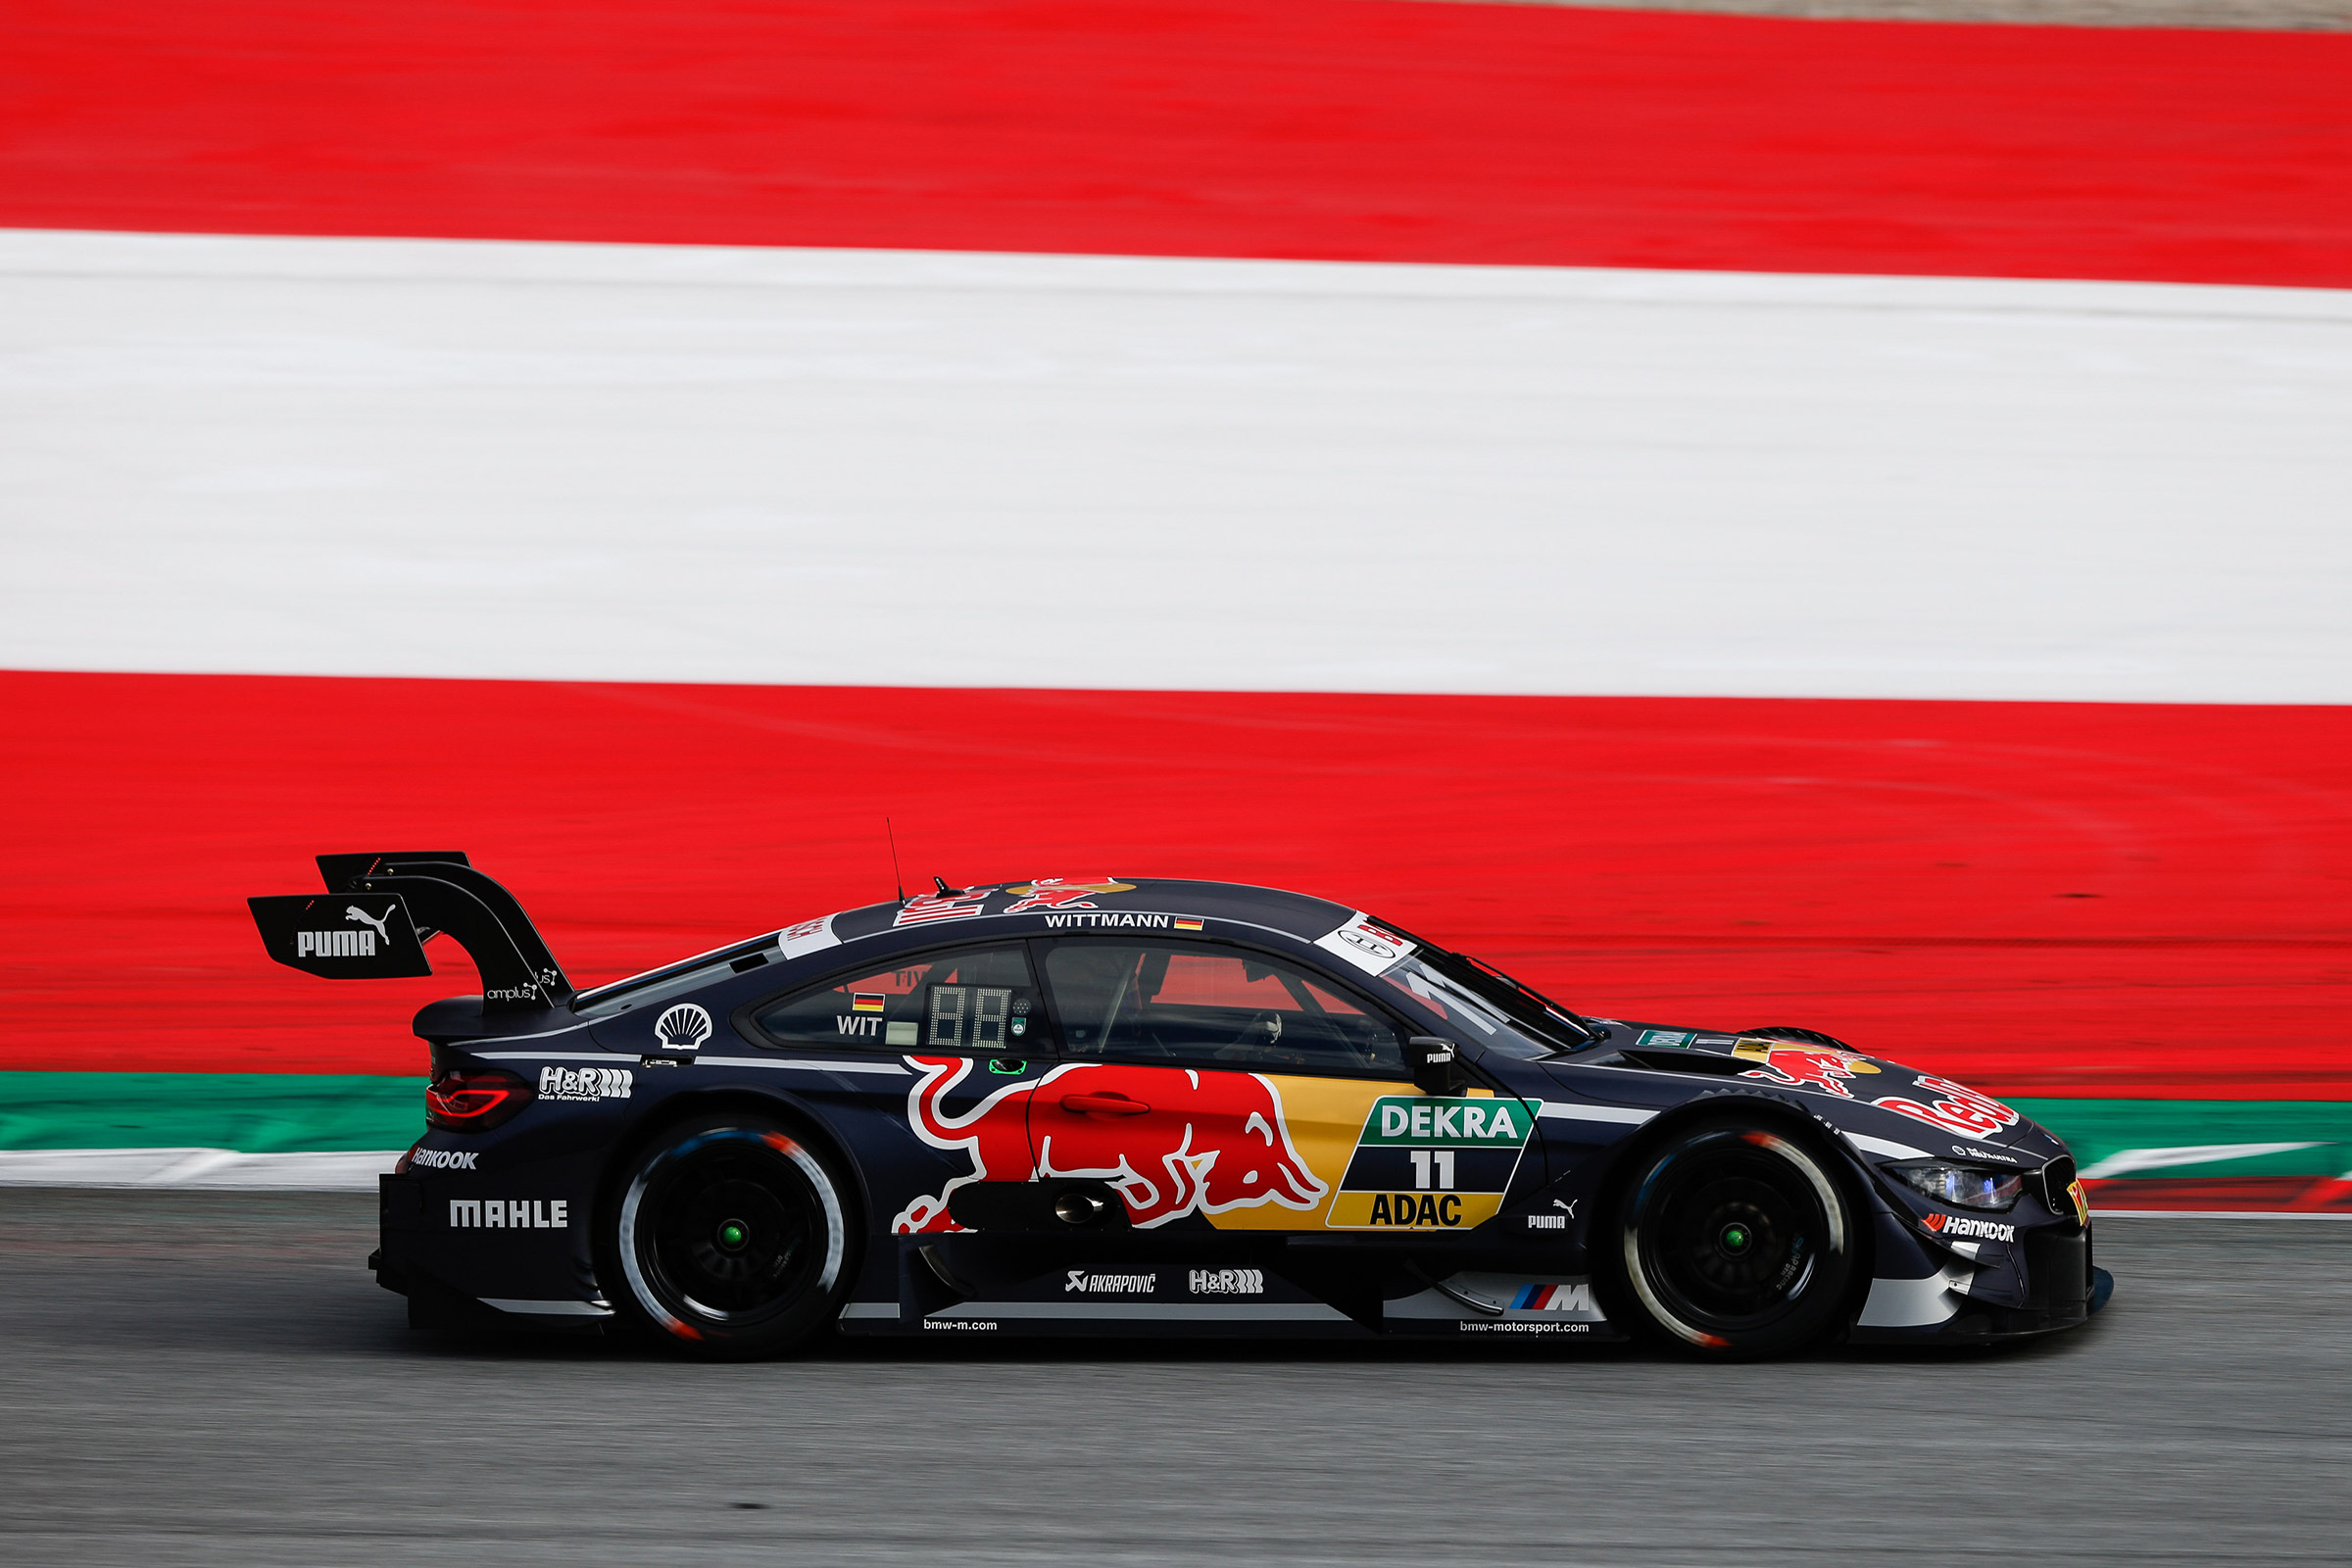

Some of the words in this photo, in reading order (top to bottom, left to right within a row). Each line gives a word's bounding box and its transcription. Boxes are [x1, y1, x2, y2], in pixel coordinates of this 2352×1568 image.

[1045, 913, 1169, 928] WITTMANN
[297, 930, 375, 957] PUMA
[487, 983, 531, 1002] amplus
[836, 1015, 882, 1037] WIT
[1427, 1052, 1451, 1063] PUMA
[539, 1066, 602, 1097] H&R
[1381, 1104, 1519, 1139] DEKRA
[1410, 1151, 1455, 1190] 11
[450, 1200, 567, 1228] MAHLE
[1369, 1194, 1462, 1227] ADAC
[1528, 1215, 1566, 1229] PUMA
[1189, 1269, 1239, 1294] H&R
[923, 1318, 998, 1331] bmw-m.com
[1460, 1320, 1590, 1334] bmw-motorsport.com
